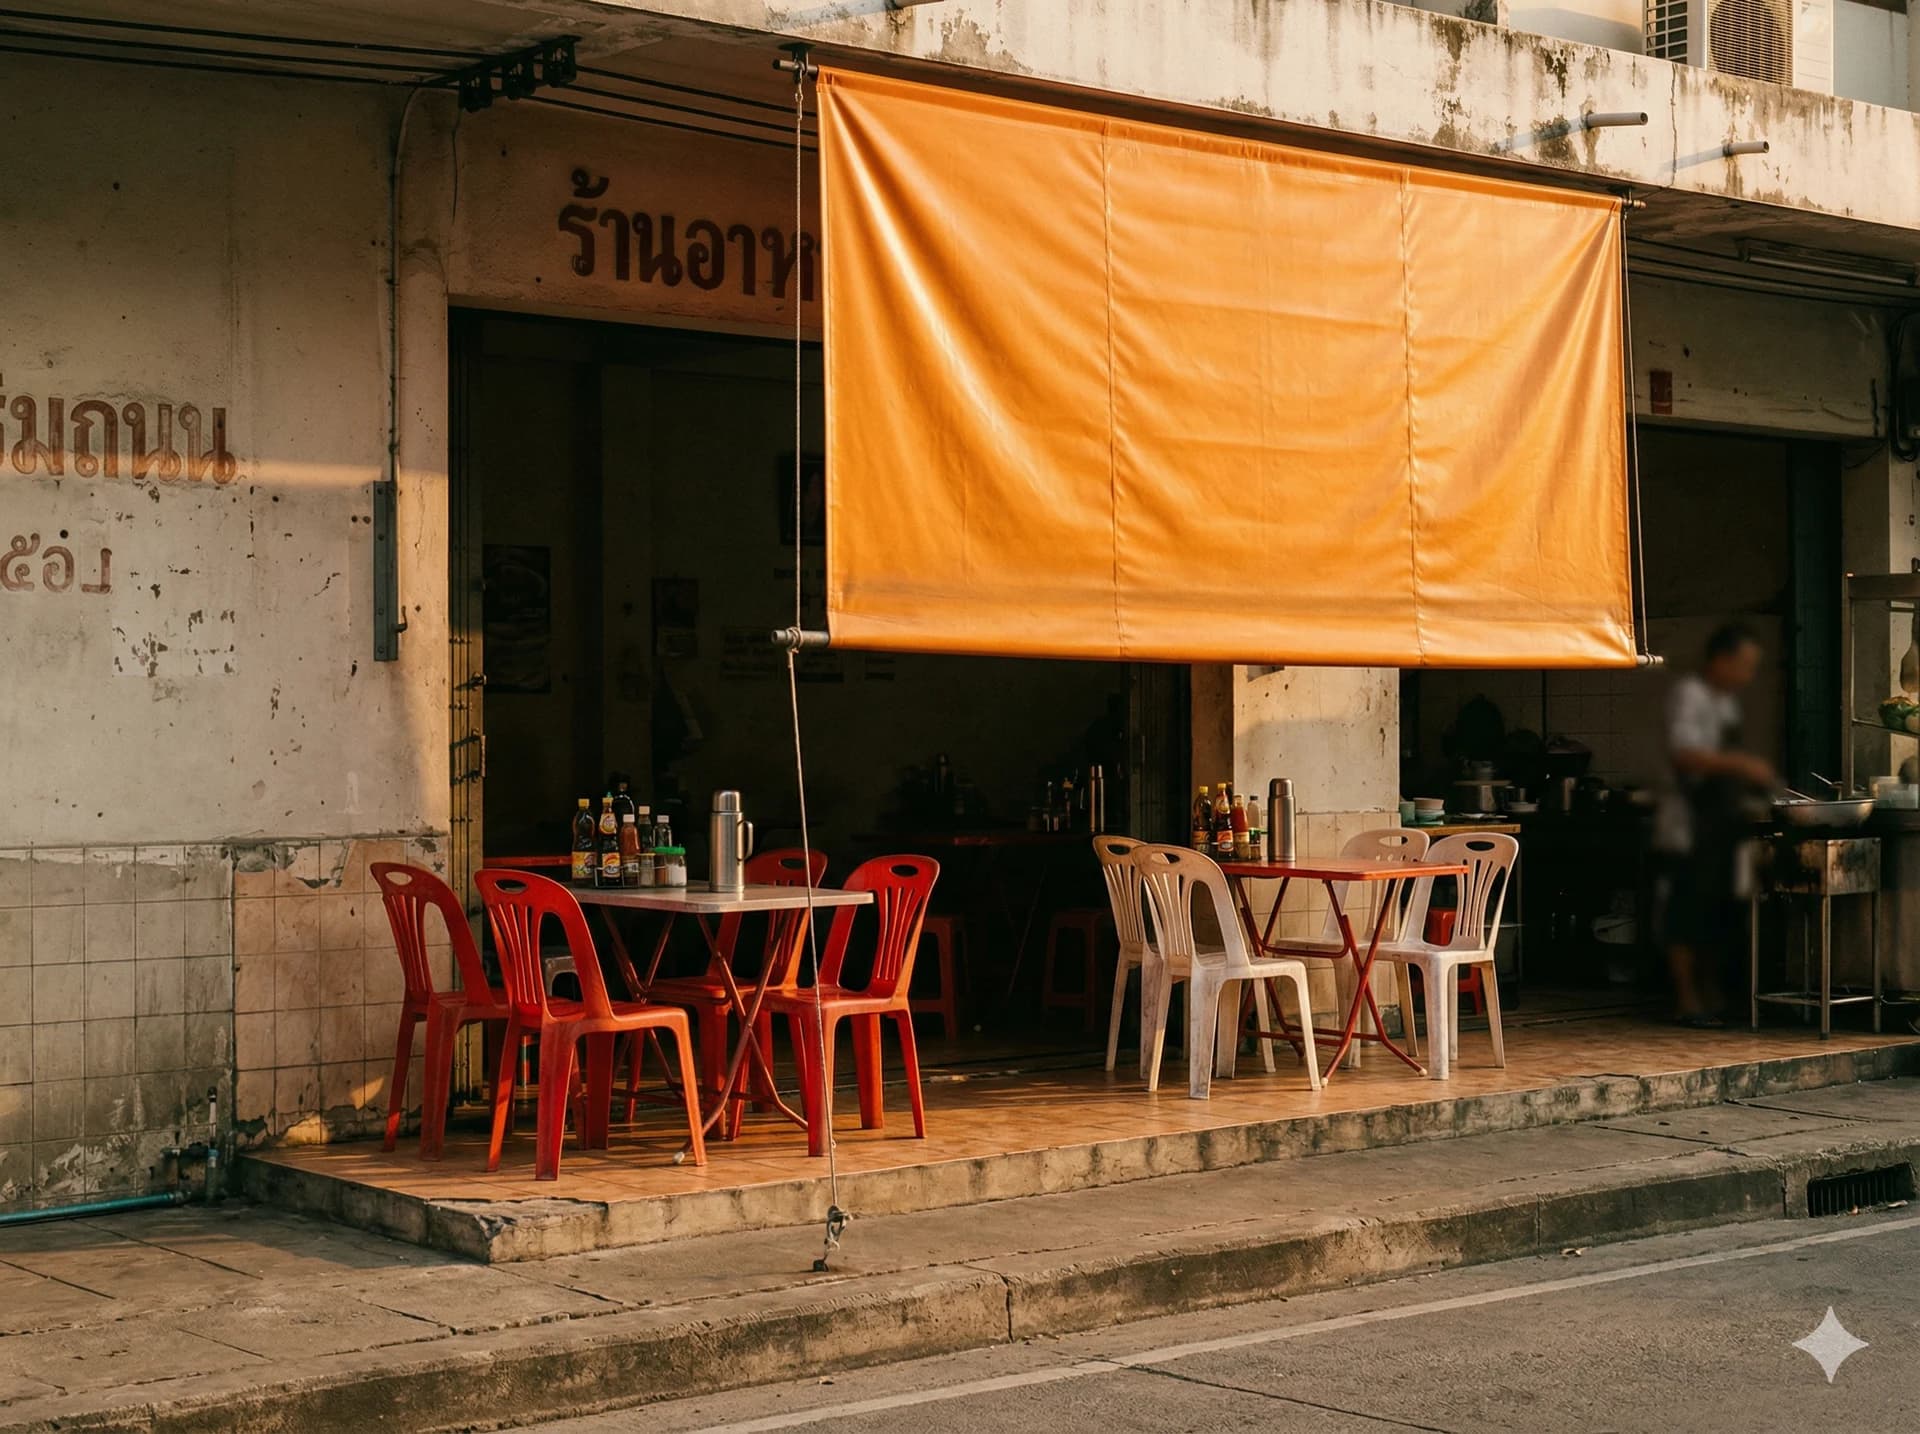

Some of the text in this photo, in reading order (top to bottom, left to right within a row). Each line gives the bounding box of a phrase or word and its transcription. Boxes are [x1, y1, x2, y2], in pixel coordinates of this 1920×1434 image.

[558, 168, 820, 302] ร้านอาห
[0, 374, 236, 485] มถนน
